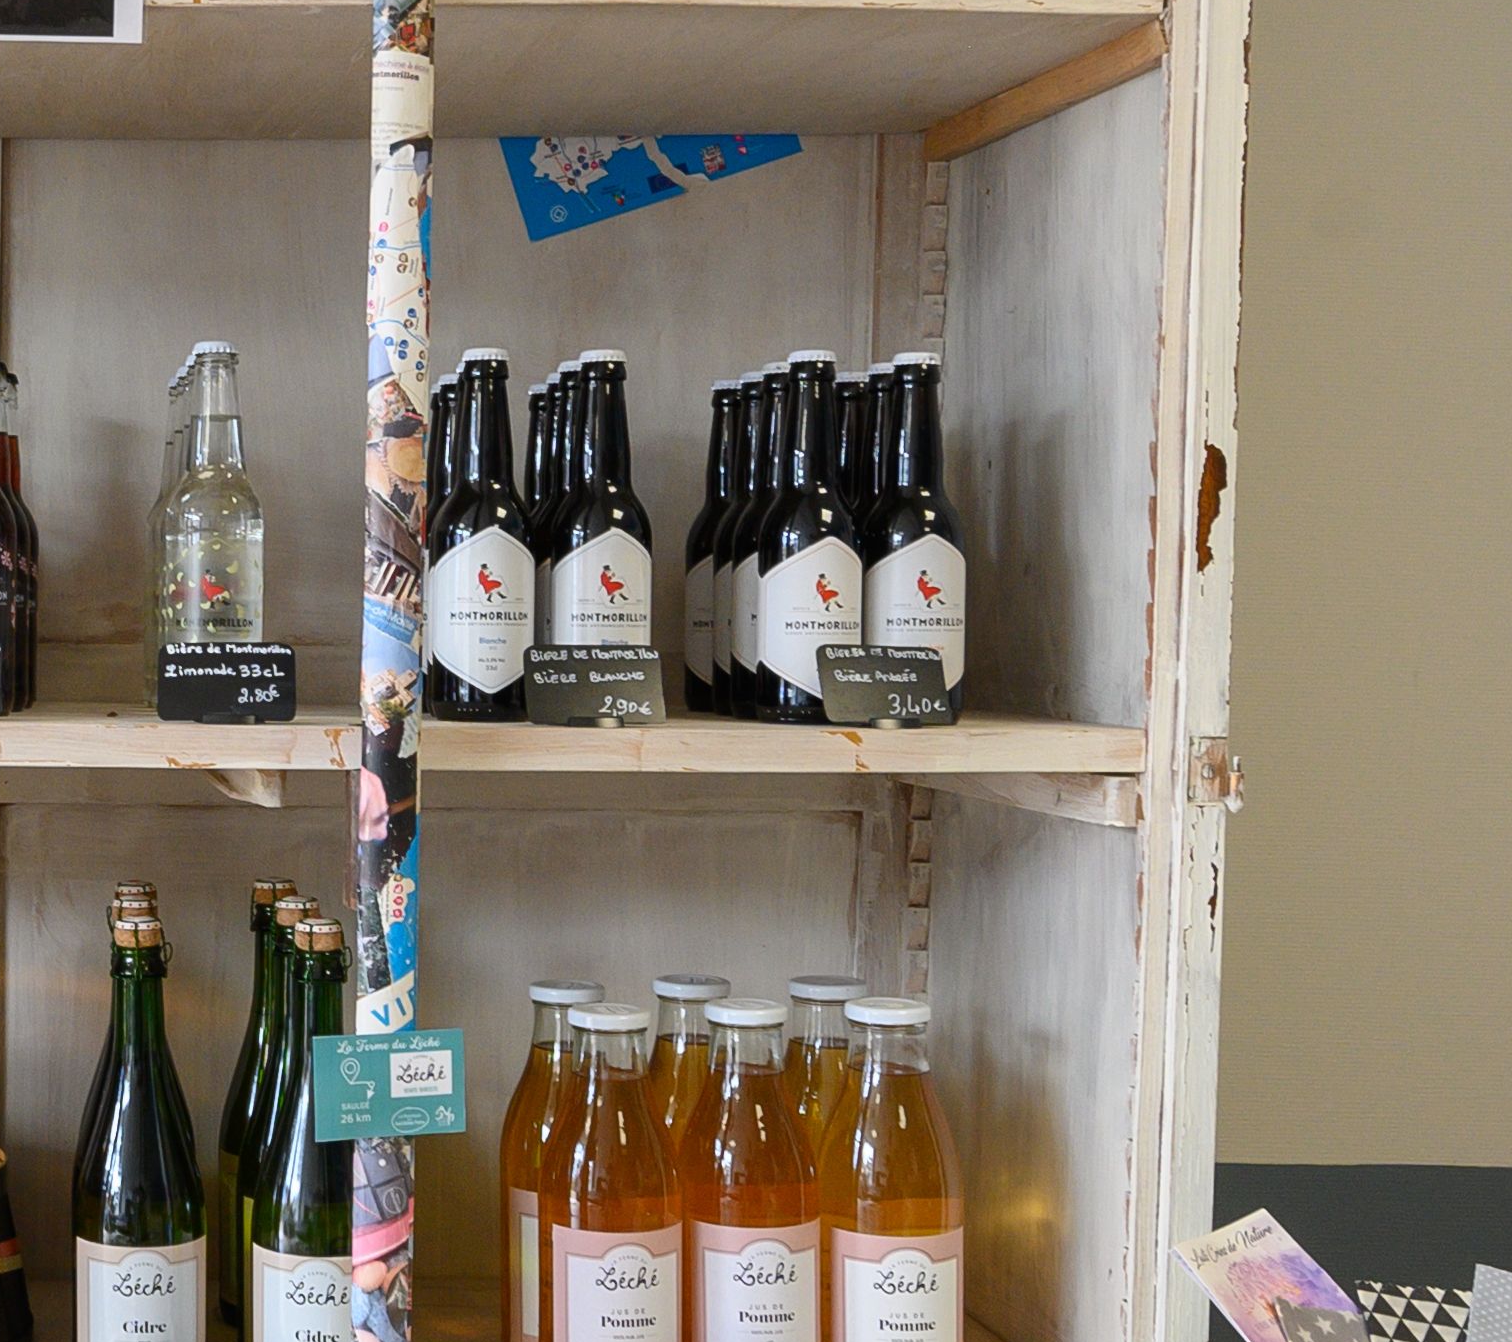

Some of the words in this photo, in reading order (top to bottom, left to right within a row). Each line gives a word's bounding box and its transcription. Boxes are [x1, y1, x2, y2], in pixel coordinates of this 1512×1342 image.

[597, 695, 653, 717] 2,90€
[888, 693, 947, 717] 3,40€
[337, 1041, 352, 1054] La
[355, 1039, 389, 1052] Ferme
[392, 1040, 408, 1050] du
[410, 1036, 440, 1049] Léché
[396, 1064, 447, 1083] Léché
[340, 1115, 353, 1124] 26
[356, 1113, 371, 1122] km
[595, 1264, 661, 1293] Léché
[732, 1261, 798, 1288] Léché
[874, 1268, 939, 1296] Léché
[112, 1271, 177, 1298] Léché
[600, 1315, 657, 1329] Pomme
[738, 1309, 795, 1325] Pomme
[878, 1317, 937, 1333] Pomme
[123, 1320, 168, 1335] Cidre
